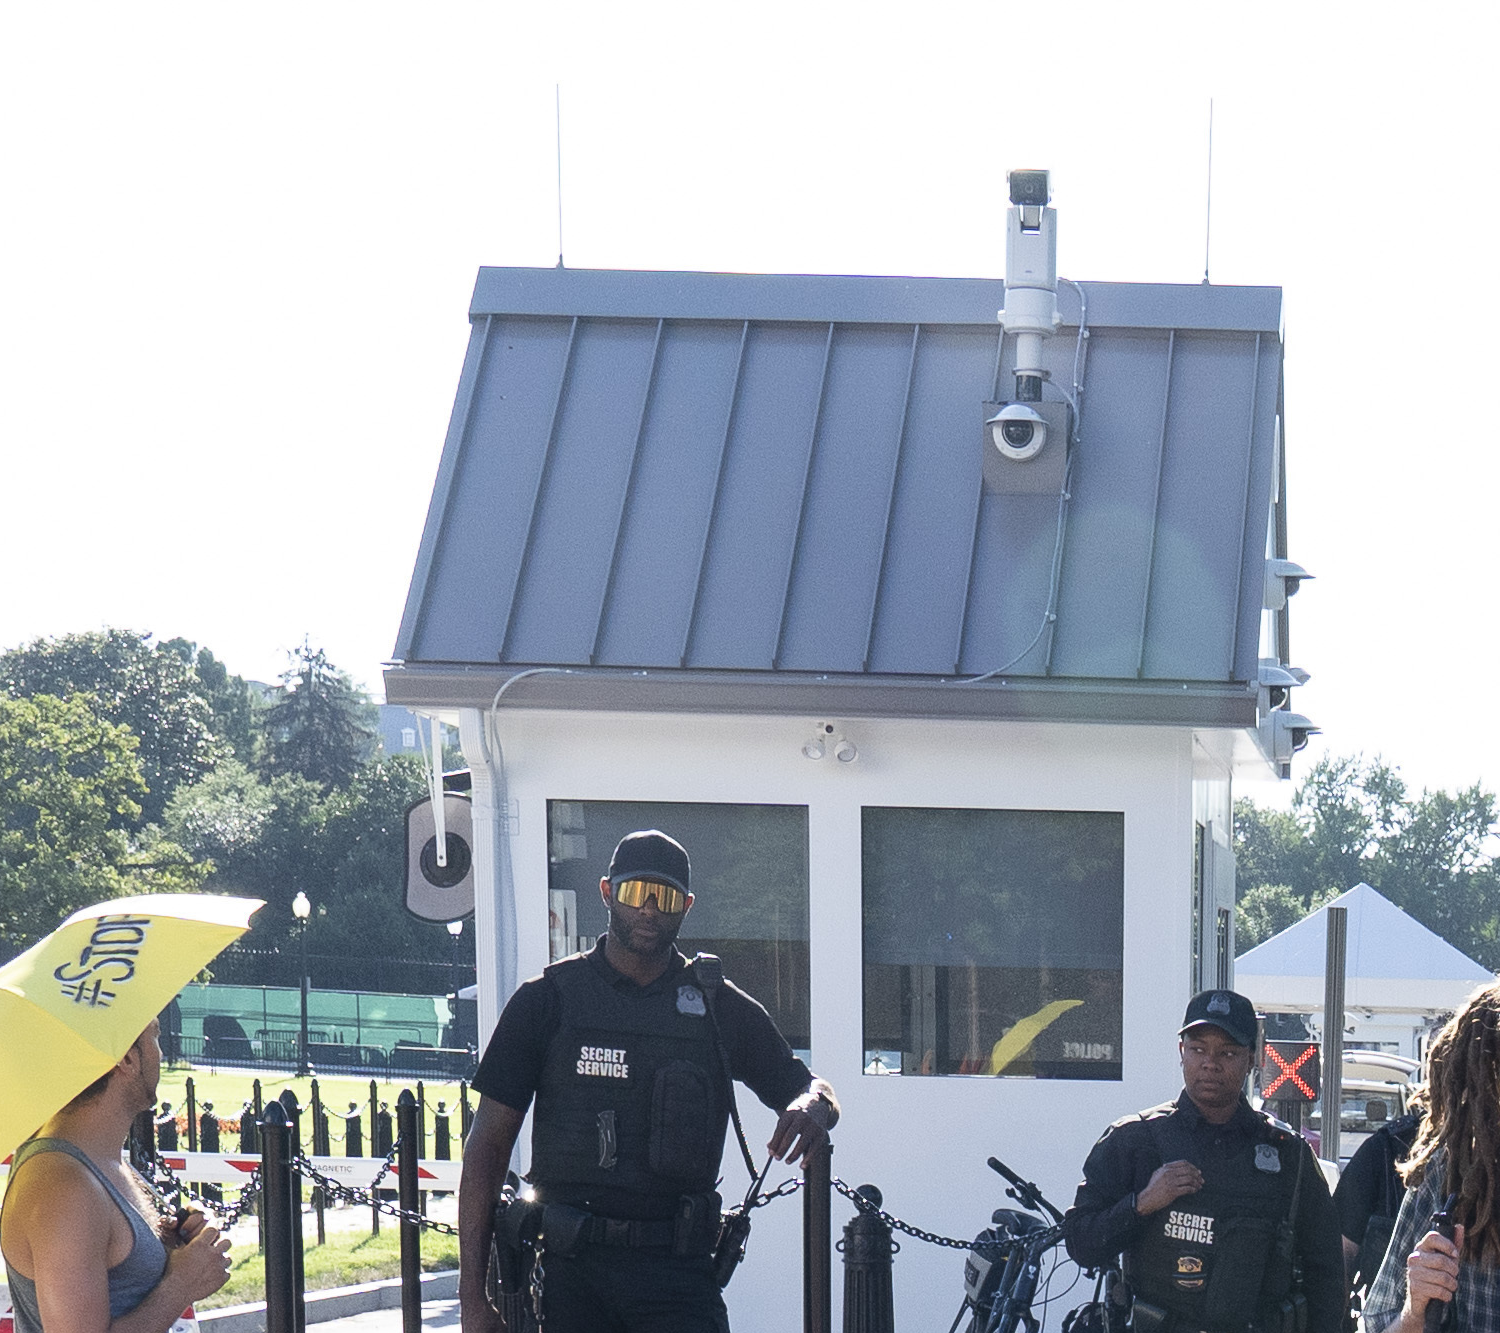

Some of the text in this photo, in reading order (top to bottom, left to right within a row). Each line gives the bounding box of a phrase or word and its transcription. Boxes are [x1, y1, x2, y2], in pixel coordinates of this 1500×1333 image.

[581, 1046, 626, 1063] SECRET
[576, 1060, 629, 1078] SERVICE
[1169, 1211, 1214, 1230] SECRET
[1164, 1223, 1214, 1245] SERVICE
